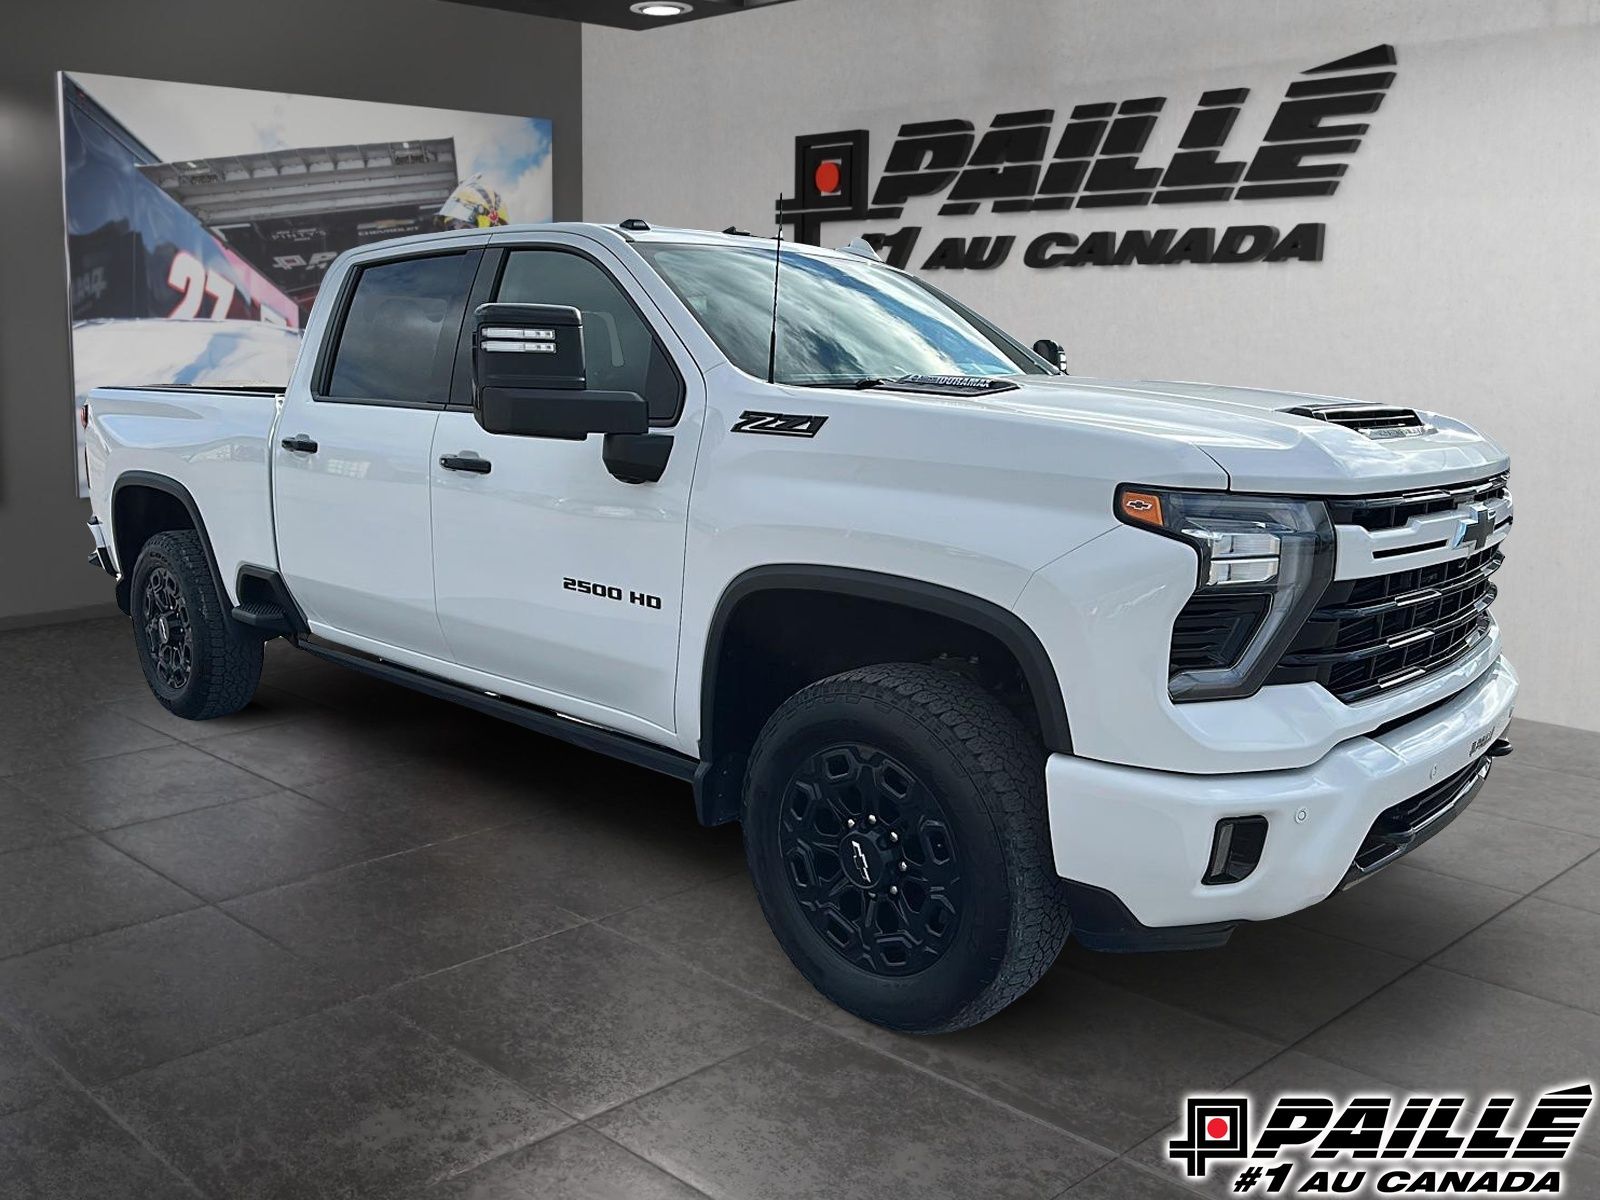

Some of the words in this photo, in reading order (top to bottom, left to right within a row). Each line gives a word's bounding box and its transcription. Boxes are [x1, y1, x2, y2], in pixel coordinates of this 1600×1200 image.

[868, 44, 1397, 219] PAILLÉ
[920, 235, 1017, 270] AU
[1023, 223, 1326, 269] CANADA
[563, 577, 622, 601] 2500
[629, 591, 662, 610] HD
